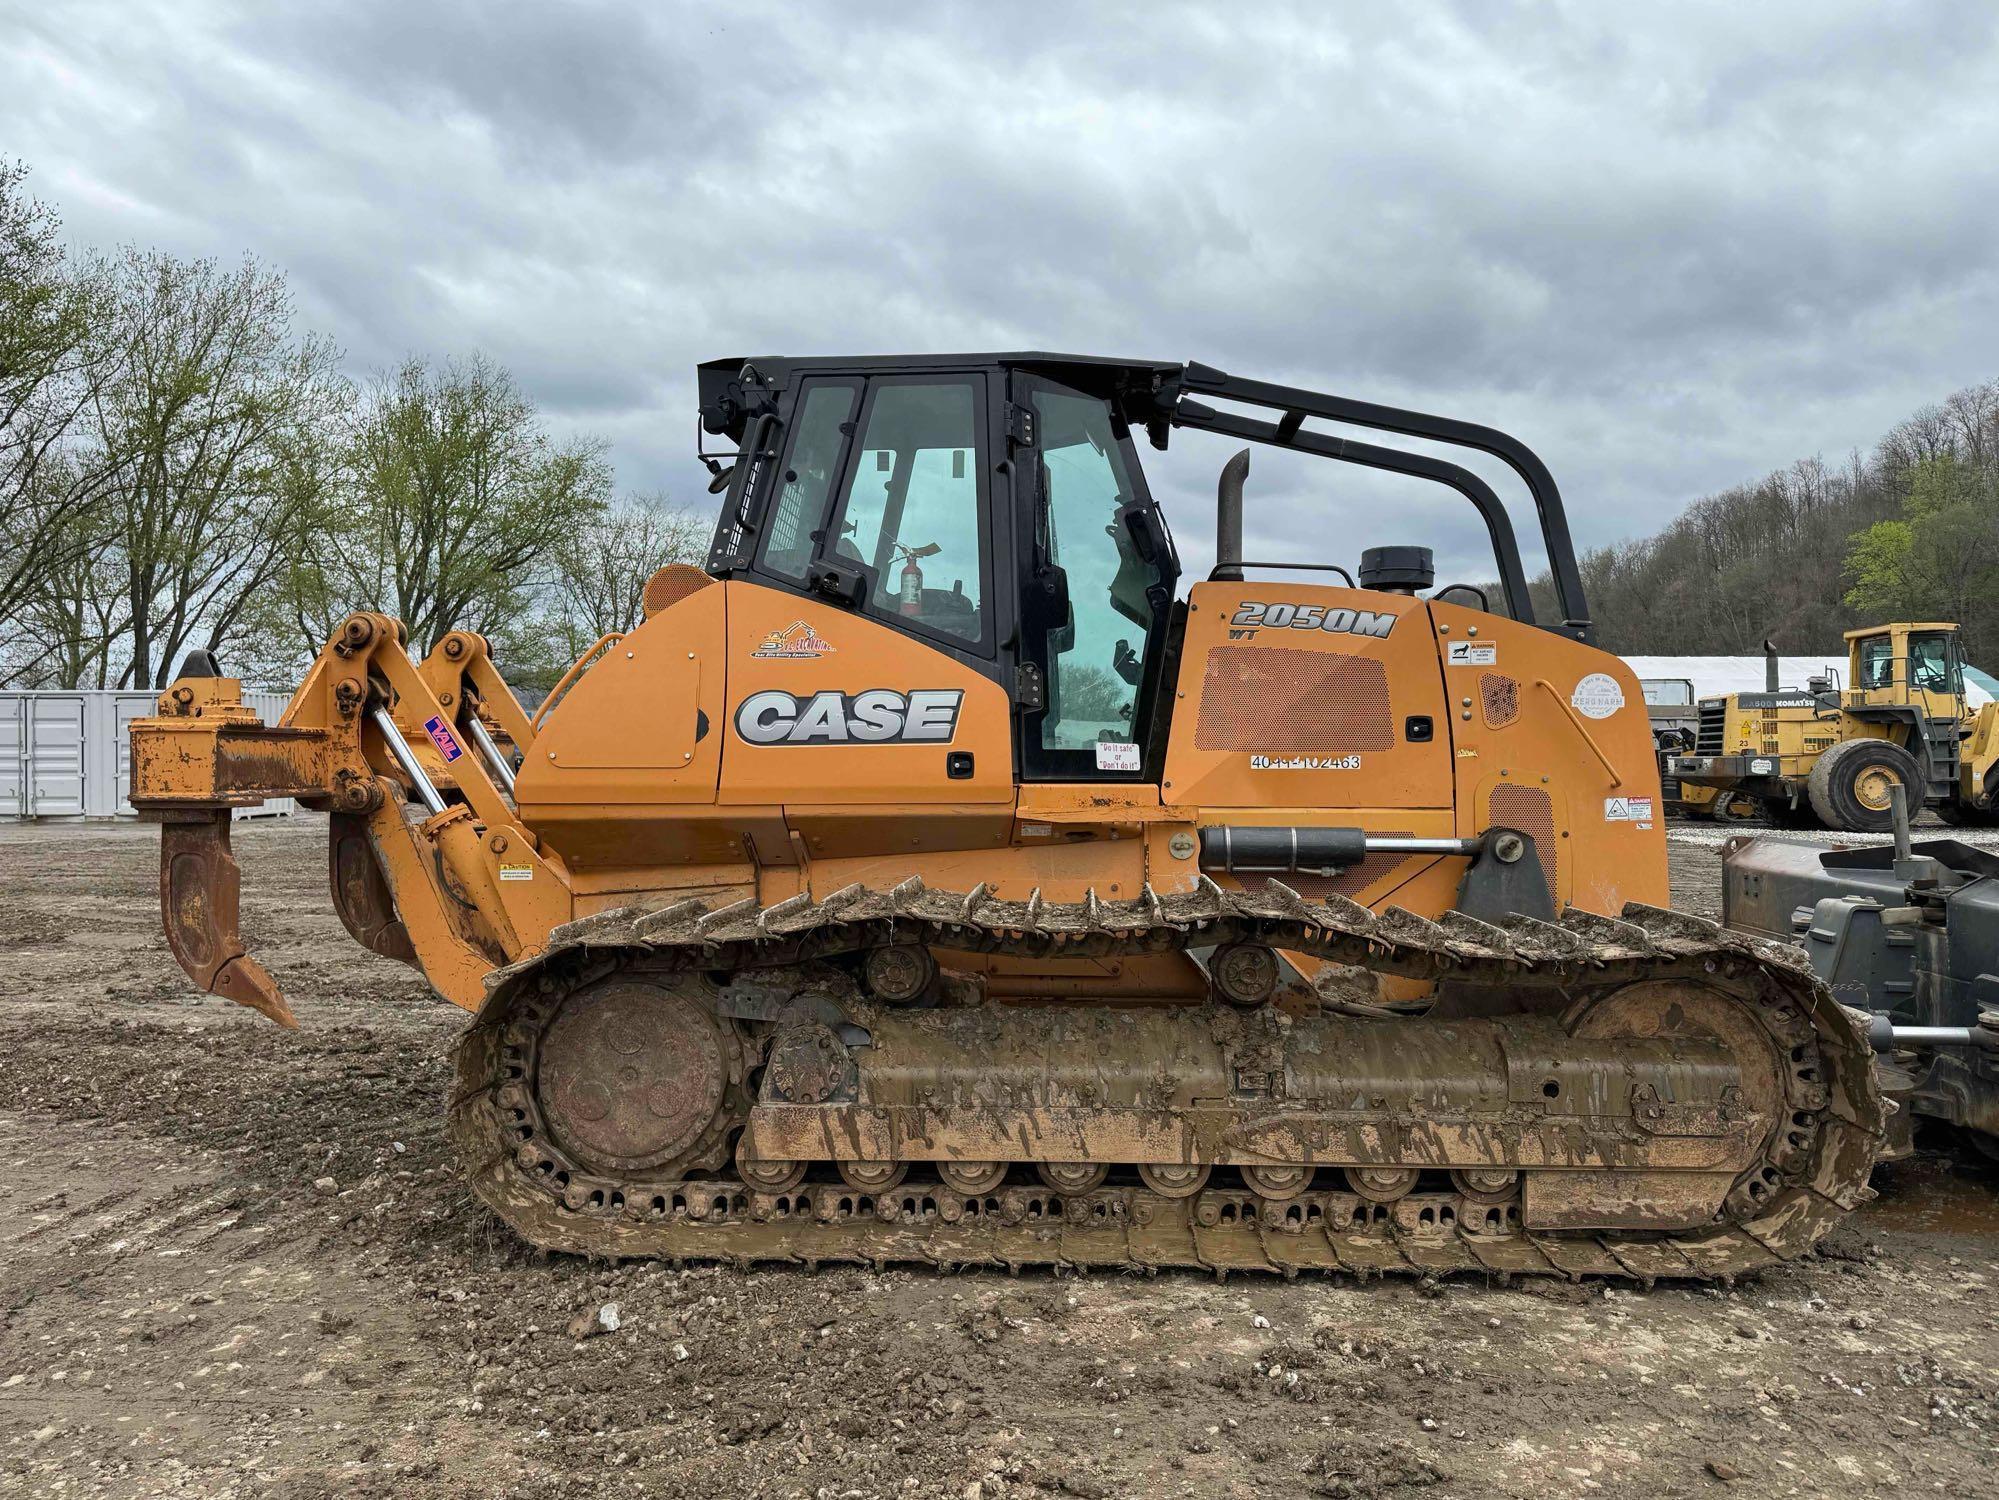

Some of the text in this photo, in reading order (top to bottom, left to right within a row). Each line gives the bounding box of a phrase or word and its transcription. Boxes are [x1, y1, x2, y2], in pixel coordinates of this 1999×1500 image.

[1229, 629, 1259, 640] WT
[1231, 602, 1397, 639] 2050M
[738, 690, 962, 743] CASE
[1776, 698, 1815, 707] KOMATSU
[432, 718, 457, 758] VAIL
